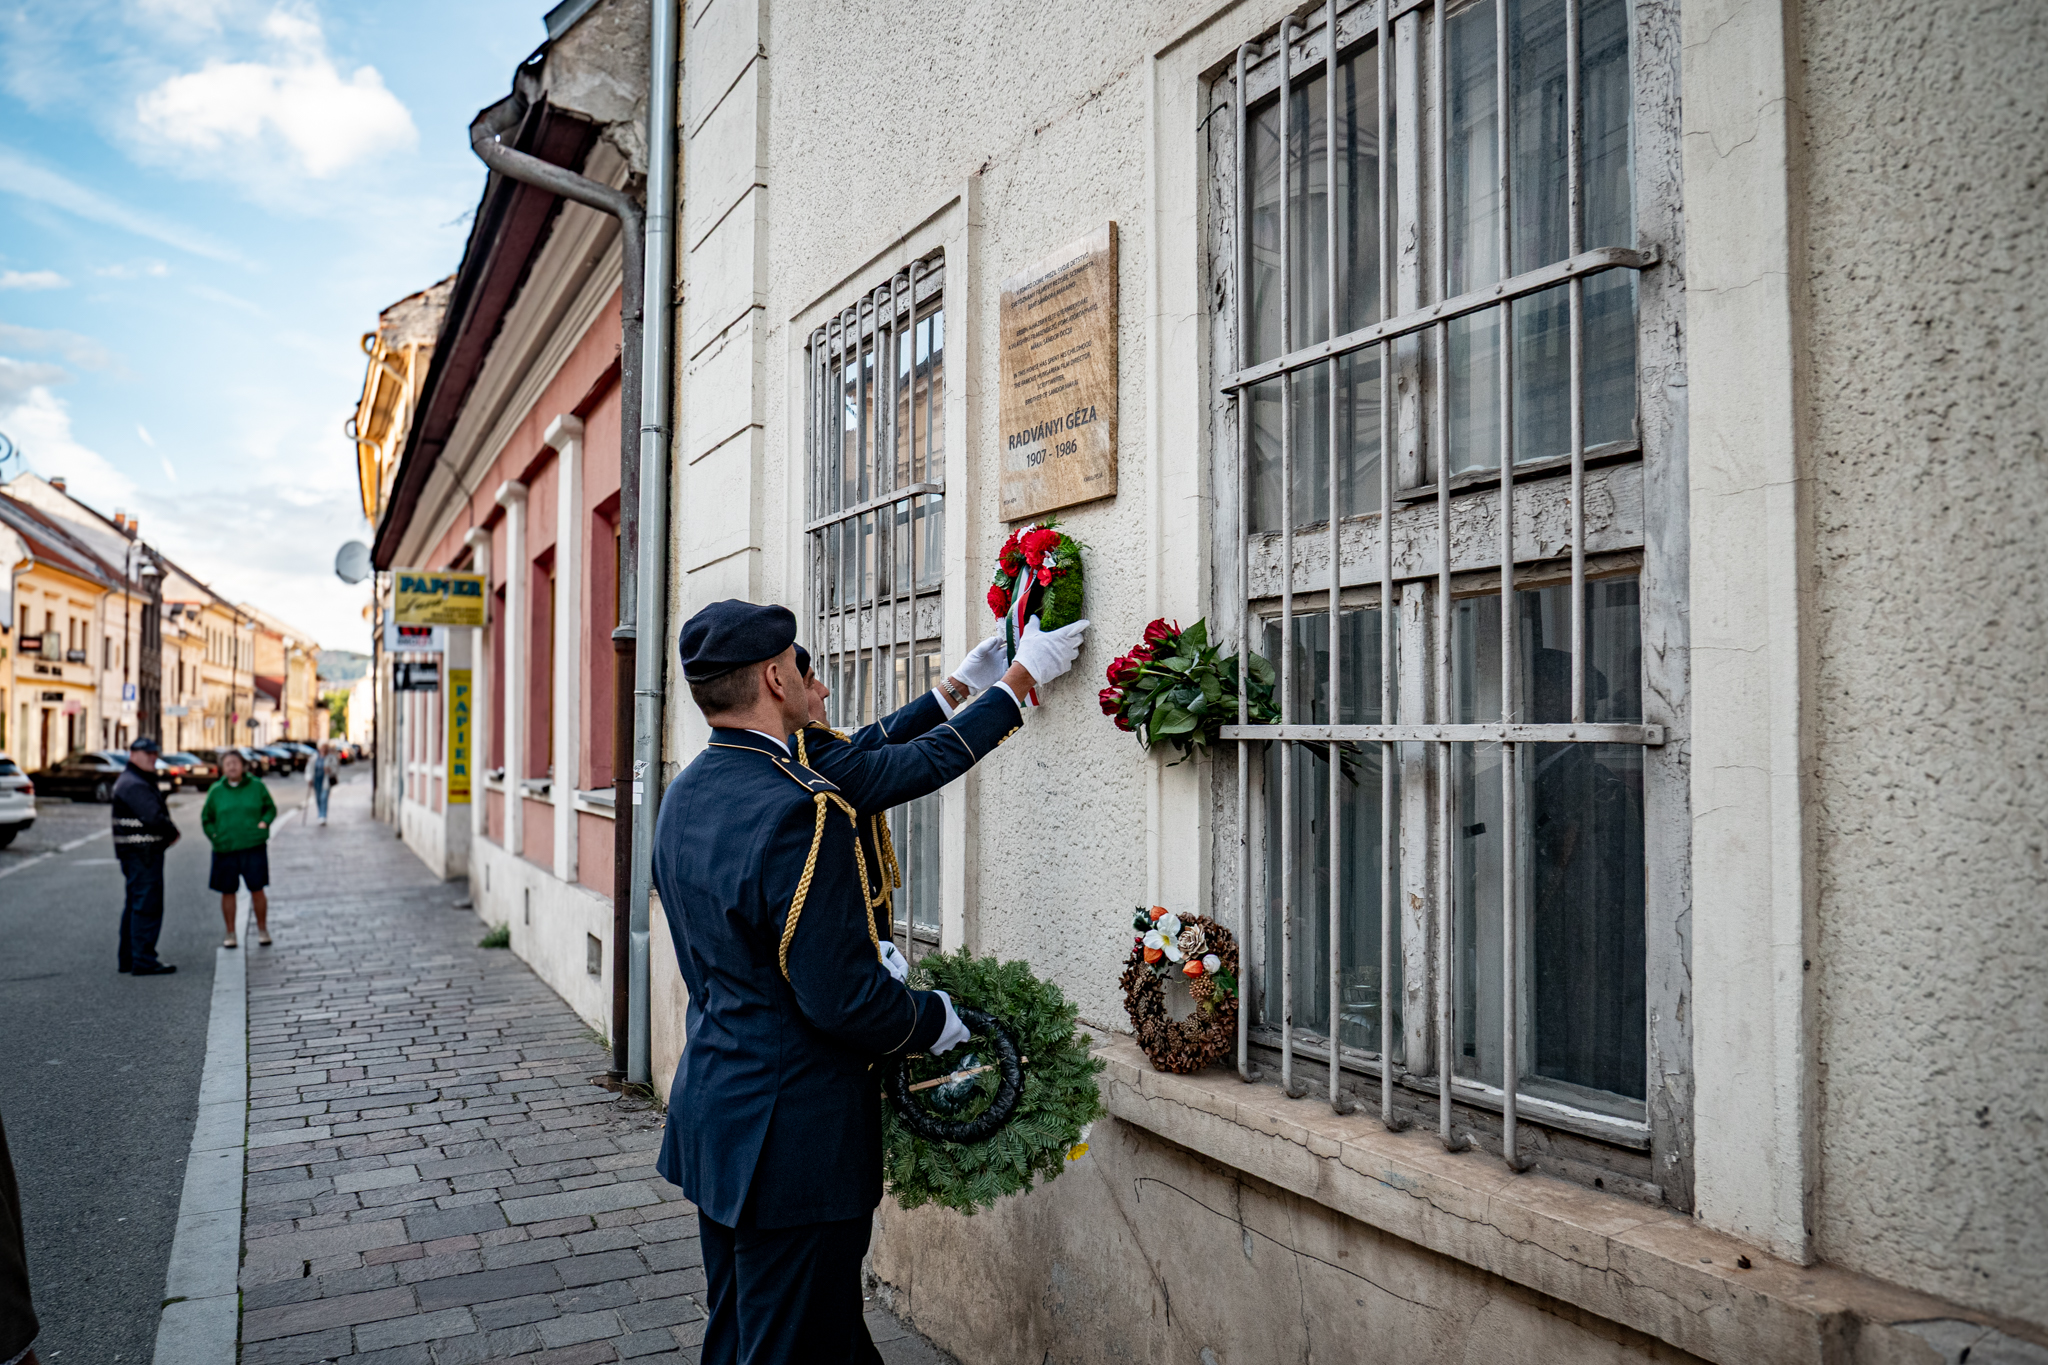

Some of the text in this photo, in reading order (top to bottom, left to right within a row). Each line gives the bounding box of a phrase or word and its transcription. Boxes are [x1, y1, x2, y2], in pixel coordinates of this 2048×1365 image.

[1009, 405, 1097, 450] RADVÁNYI GÉZA
[1027, 449, 1046, 467] 1907
[1056, 439, 1077, 458] 1986
